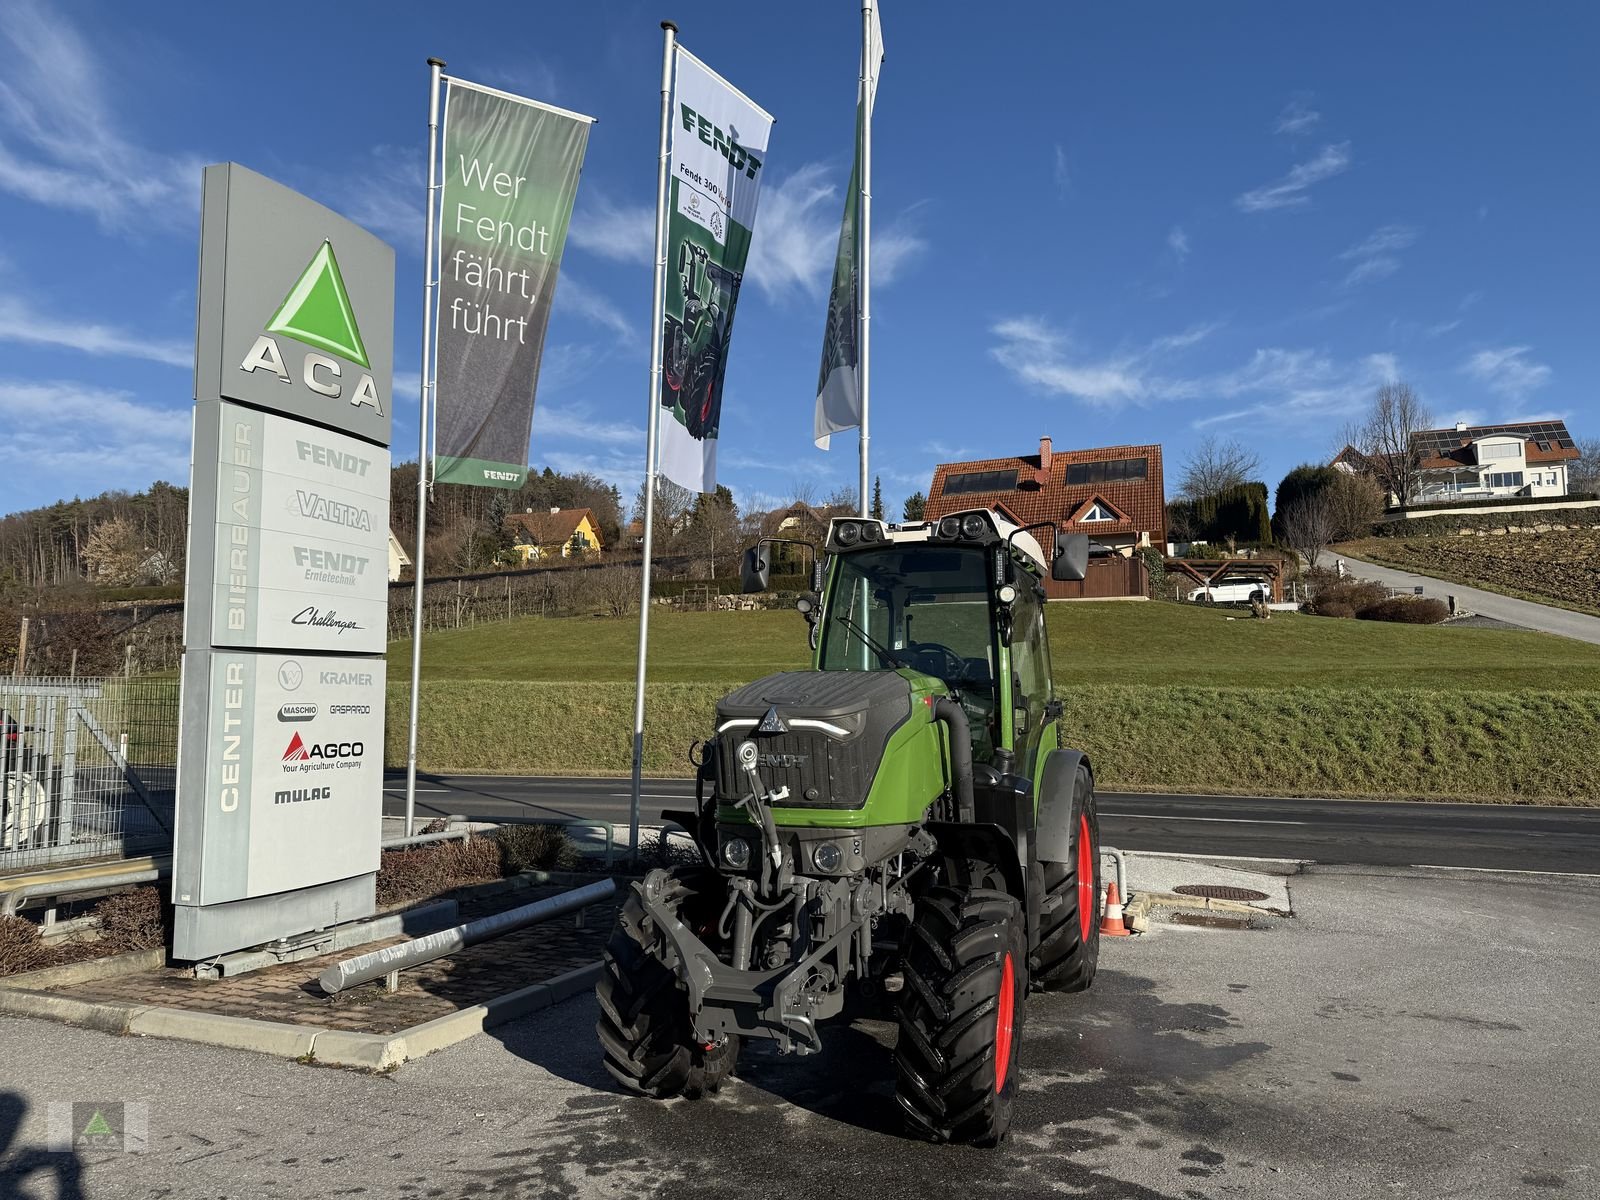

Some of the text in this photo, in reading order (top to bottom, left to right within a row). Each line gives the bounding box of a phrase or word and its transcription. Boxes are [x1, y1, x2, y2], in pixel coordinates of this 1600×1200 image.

[680, 102, 762, 180] FENDT
[459, 154, 527, 200] Wer
[680, 163, 702, 185] Fendt
[703, 178, 718, 194] 300
[455, 202, 550, 256] Fendt
[452, 250, 537, 305] fährt,
[450, 297, 529, 345] führt
[240, 335, 384, 418] ACA
[295, 439, 372, 477] FENDT
[483, 469, 520, 482] FENDT
[296, 489, 371, 532] VALTRA
[228, 422, 252, 630] BIERBAUER
[293, 546, 370, 576] FENDT
[304, 568, 357, 586] Erntetechnik
[291, 606, 366, 635] Challenger
[319, 671, 373, 686] KRAMER
[283, 706, 317, 714] MASCHIO
[329, 704, 371, 715] GASPARDO
[220, 662, 244, 813] CENTER
[309, 742, 364, 759] AGCO
[282, 760, 362, 774] Your Agriculture Company
[756, 753, 809, 768] ENDT
[274, 786, 331, 805] MULAG
